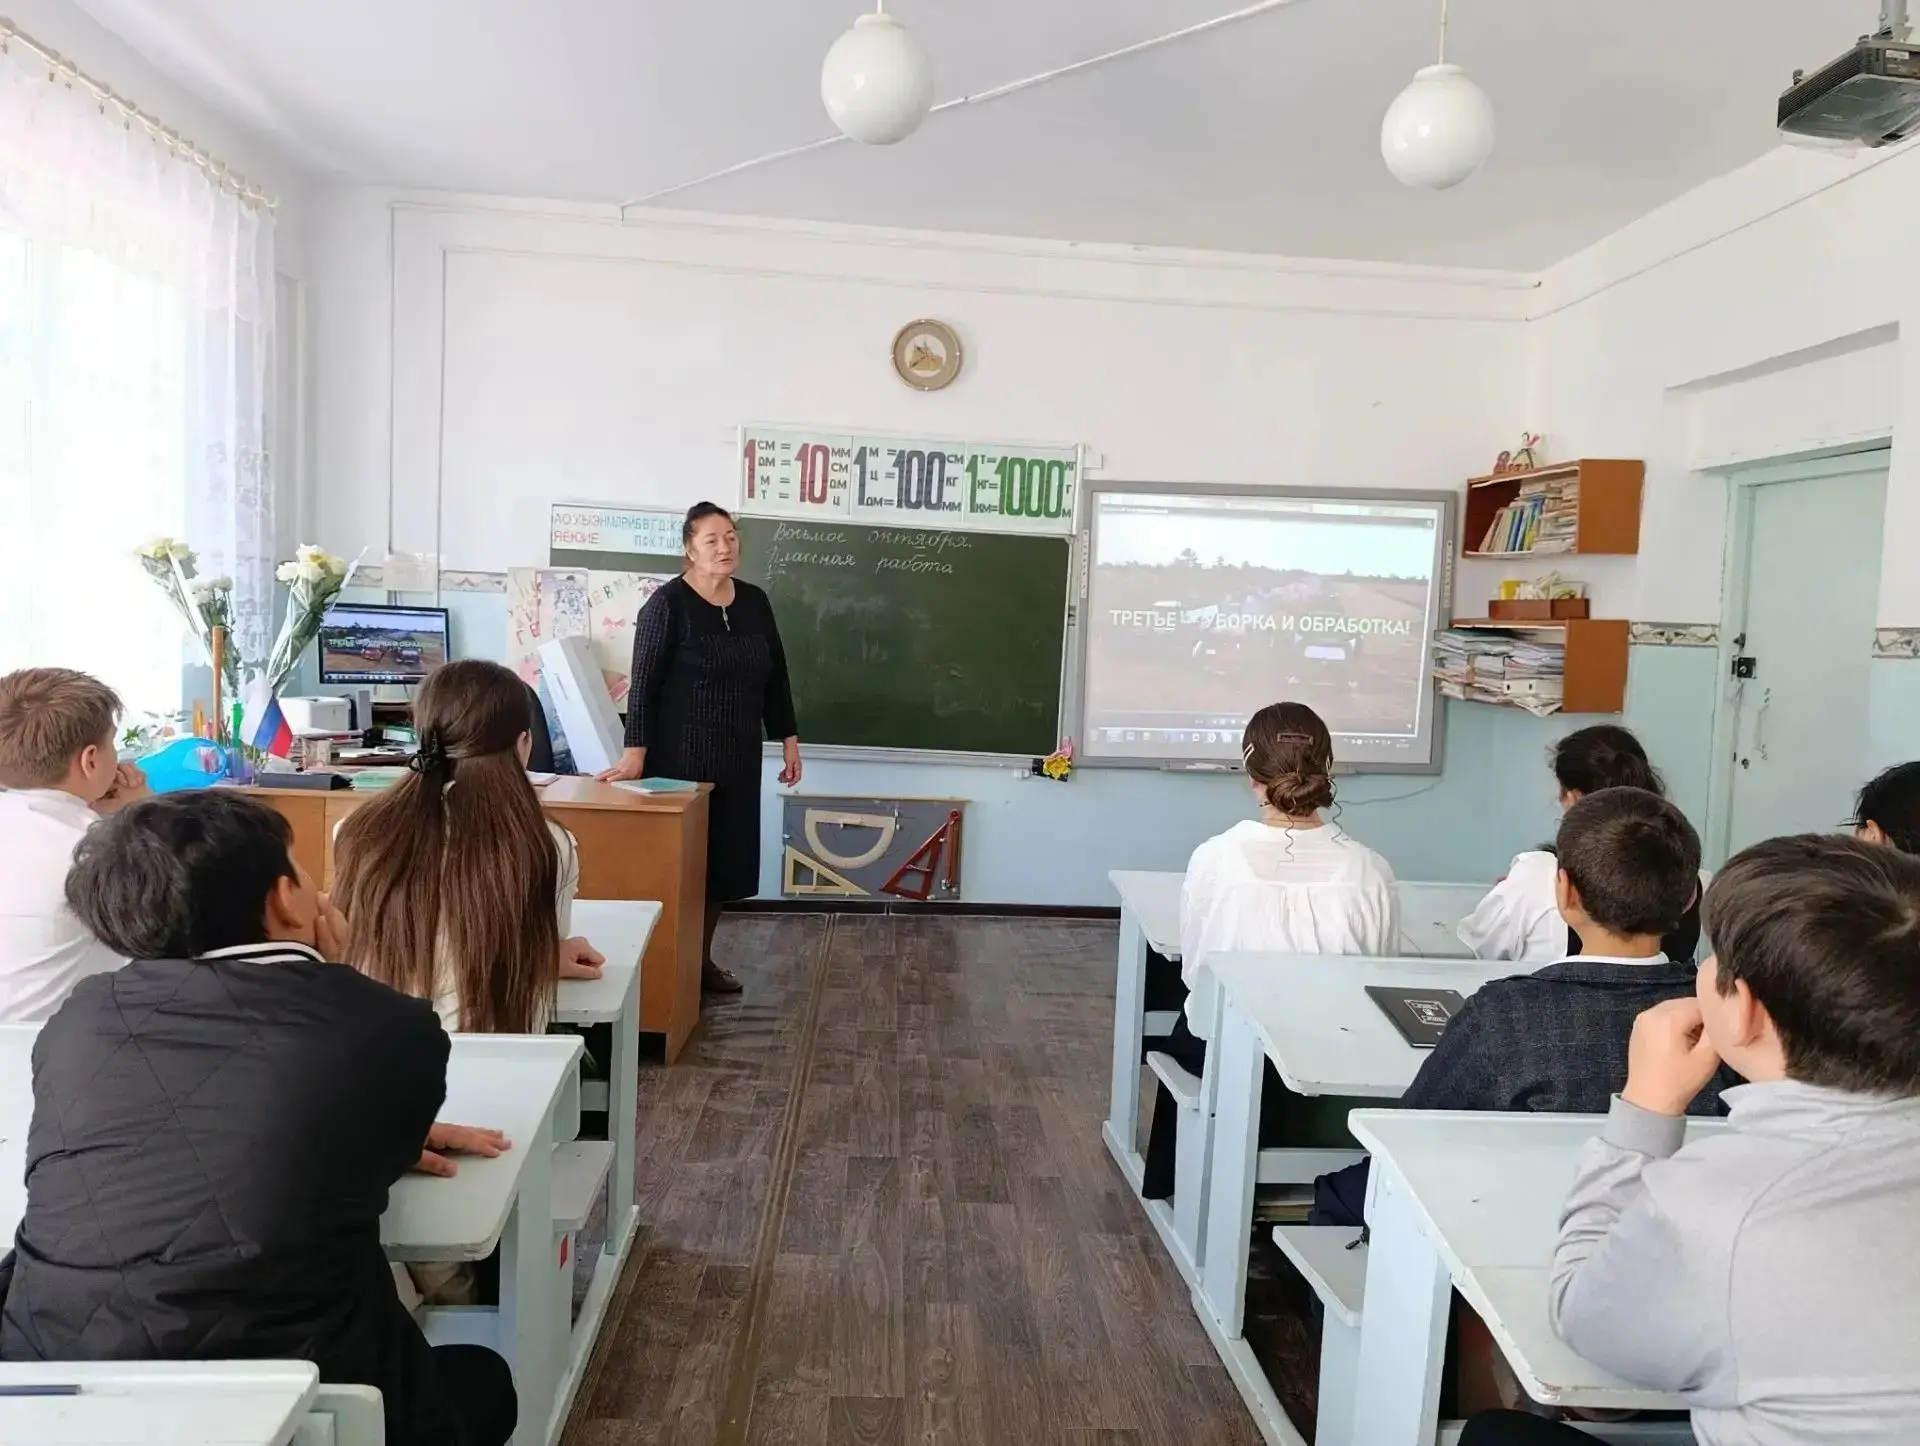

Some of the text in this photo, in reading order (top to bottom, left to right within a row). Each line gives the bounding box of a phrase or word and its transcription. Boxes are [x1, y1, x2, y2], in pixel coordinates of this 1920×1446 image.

[744, 439, 757, 498] 1
[794, 443, 830, 504] 10
[853, 446, 867, 506] 1
[892, 450, 946, 511] 100
[966, 455, 978, 513] 1
[994, 456, 1065, 518] 1000
[875, 553, 954, 574] работа
[1109, 609, 1177, 627] ТРЕТЬЕ
[1282, 615, 1295, 631] И
[1300, 616, 1411, 635] ОБРАБОТКА!
